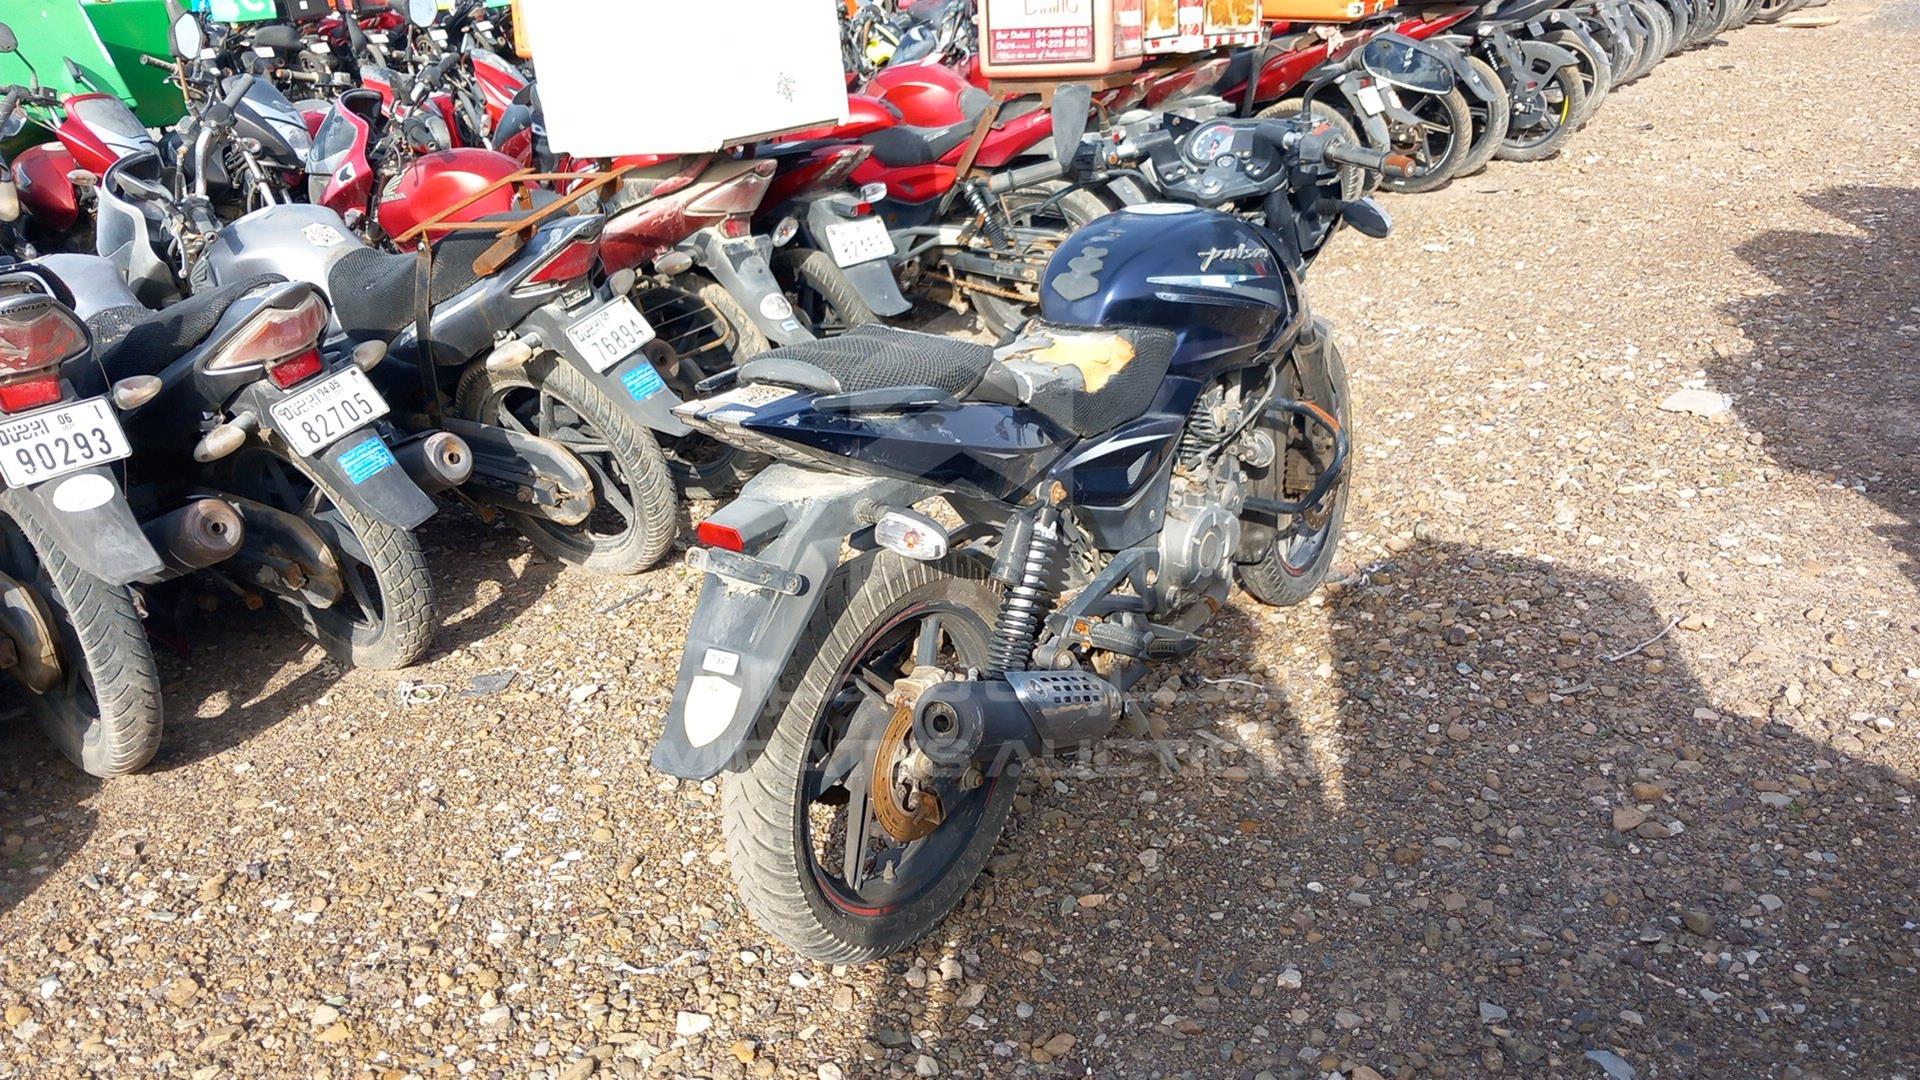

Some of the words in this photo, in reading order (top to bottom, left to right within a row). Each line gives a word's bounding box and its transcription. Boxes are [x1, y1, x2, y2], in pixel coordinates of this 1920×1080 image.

[592, 320, 645, 361] 76894
[57, 413, 73, 425] 06
[302, 393, 373, 444] 82705
[16, 428, 112, 474] 90293
